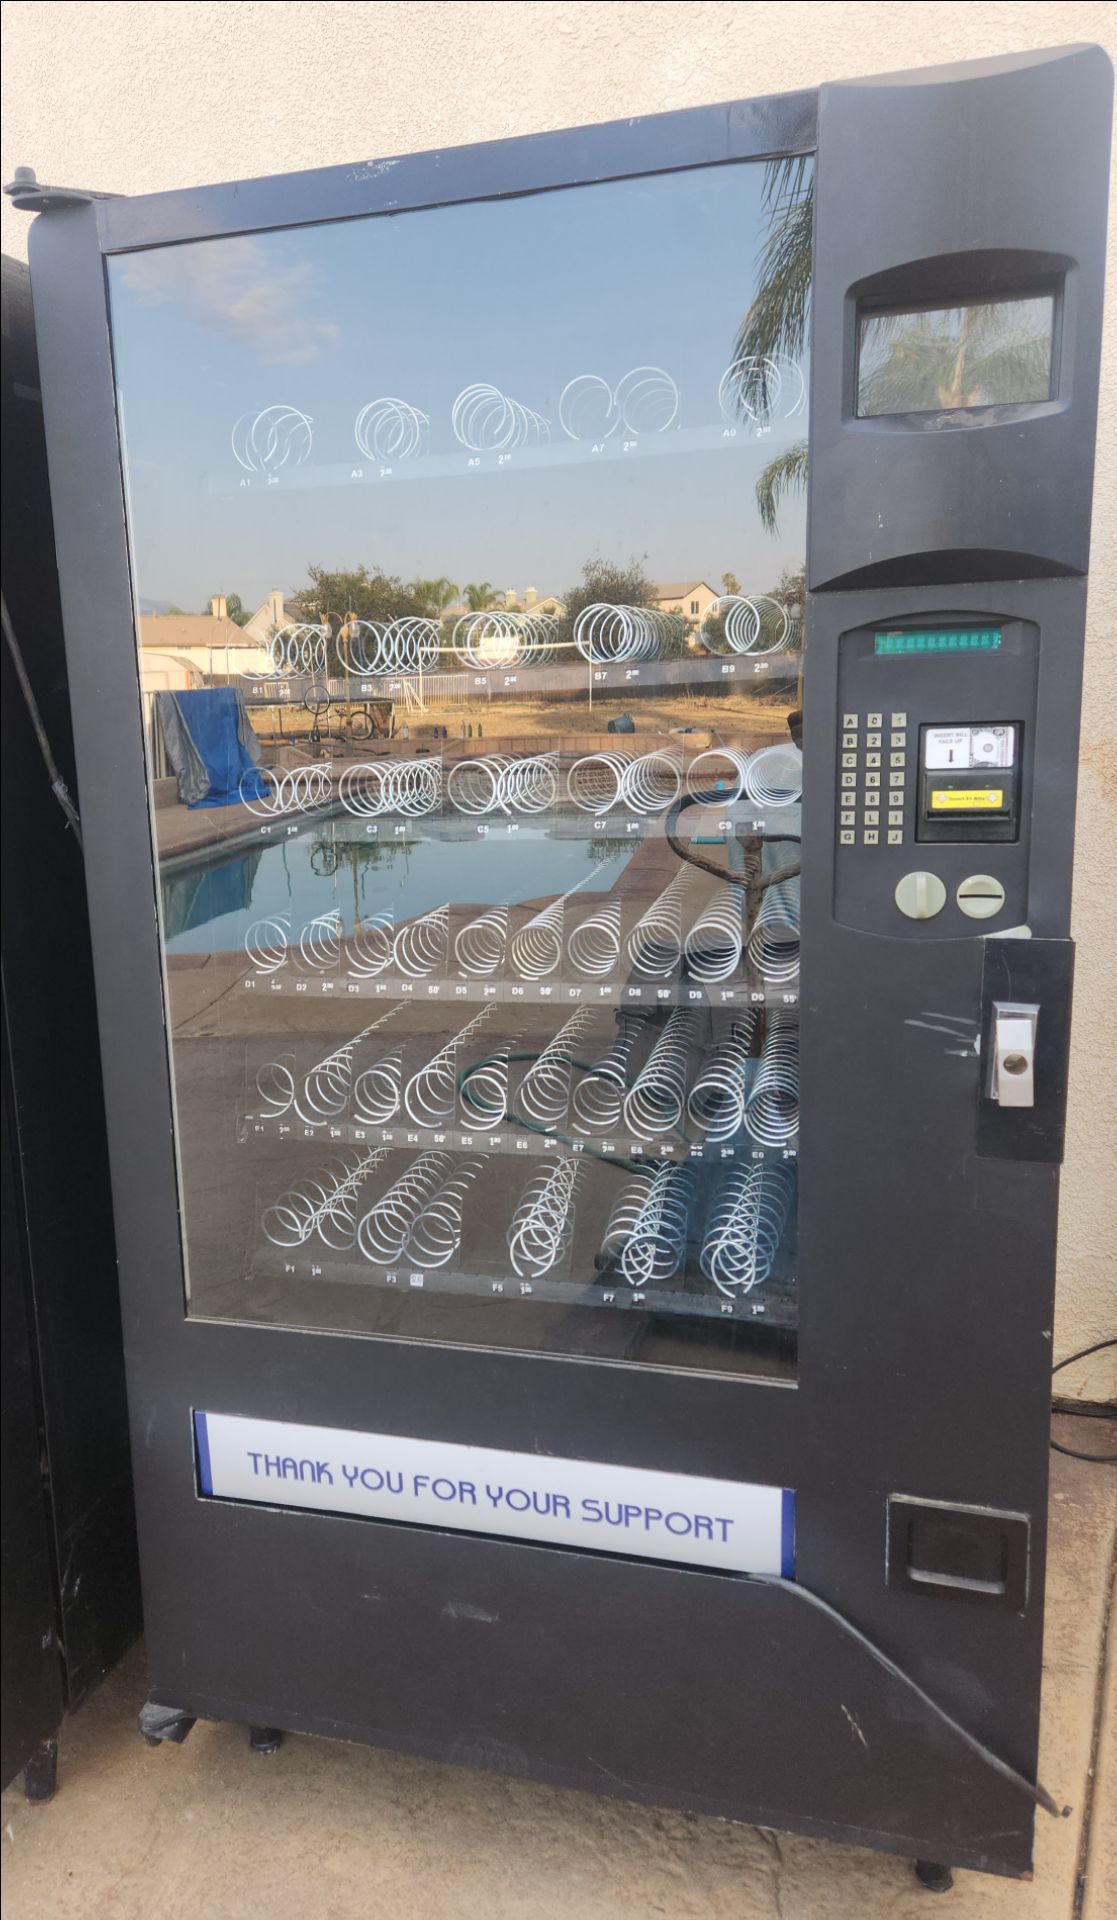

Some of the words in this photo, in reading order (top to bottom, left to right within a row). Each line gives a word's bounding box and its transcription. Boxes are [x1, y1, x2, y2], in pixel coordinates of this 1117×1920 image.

[591, 443, 605, 453] A7
[721, 664, 736, 673] B9
[594, 671, 607, 681] B7
[477, 825, 489, 834] C5
[593, 820, 607, 830] C7
[718, 820, 732, 830] C9
[260, 826, 271, 834] C1
[244, 980, 255, 988] D1
[296, 983, 307, 991] D2
[401, 983, 413, 992] D4
[455, 986, 467, 994] D5
[511, 986, 524, 995] D6
[569, 988, 581, 997] D7
[407, 1134, 418, 1142] E4
[461, 1136, 473, 1145] E5
[603, 1293, 615, 1302] F7
[247, 1452, 334, 1485] THANK
[342, 1464, 403, 1494] YOU
[414, 1475, 476, 1505] FOR
[486, 1484, 571, 1519] YOUR
[581, 1498, 734, 1542] SUPPORT
